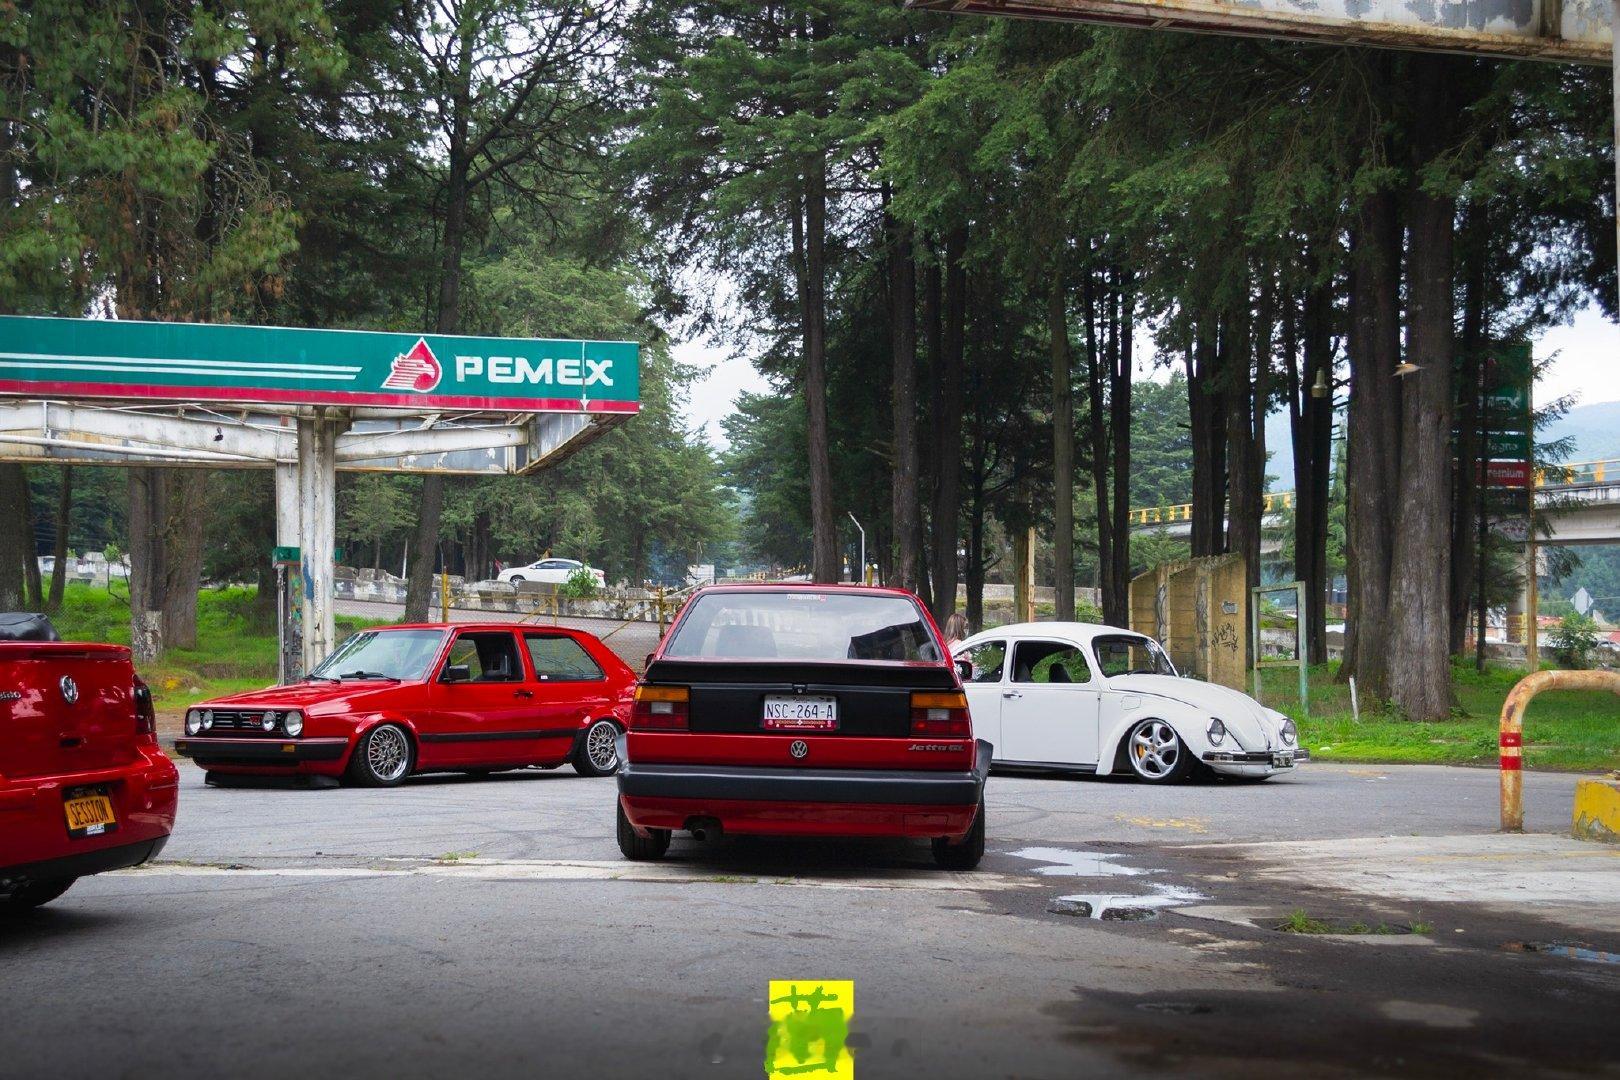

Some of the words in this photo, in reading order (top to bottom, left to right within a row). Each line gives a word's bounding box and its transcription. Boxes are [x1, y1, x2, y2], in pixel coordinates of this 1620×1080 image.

[455, 356, 614, 386] PEMEX
[1487, 467, 1524, 479] remium
[766, 703, 834, 719] NSC-264-A
[908, 744, 947, 752] Jetta
[69, 797, 109, 826] SESSION
